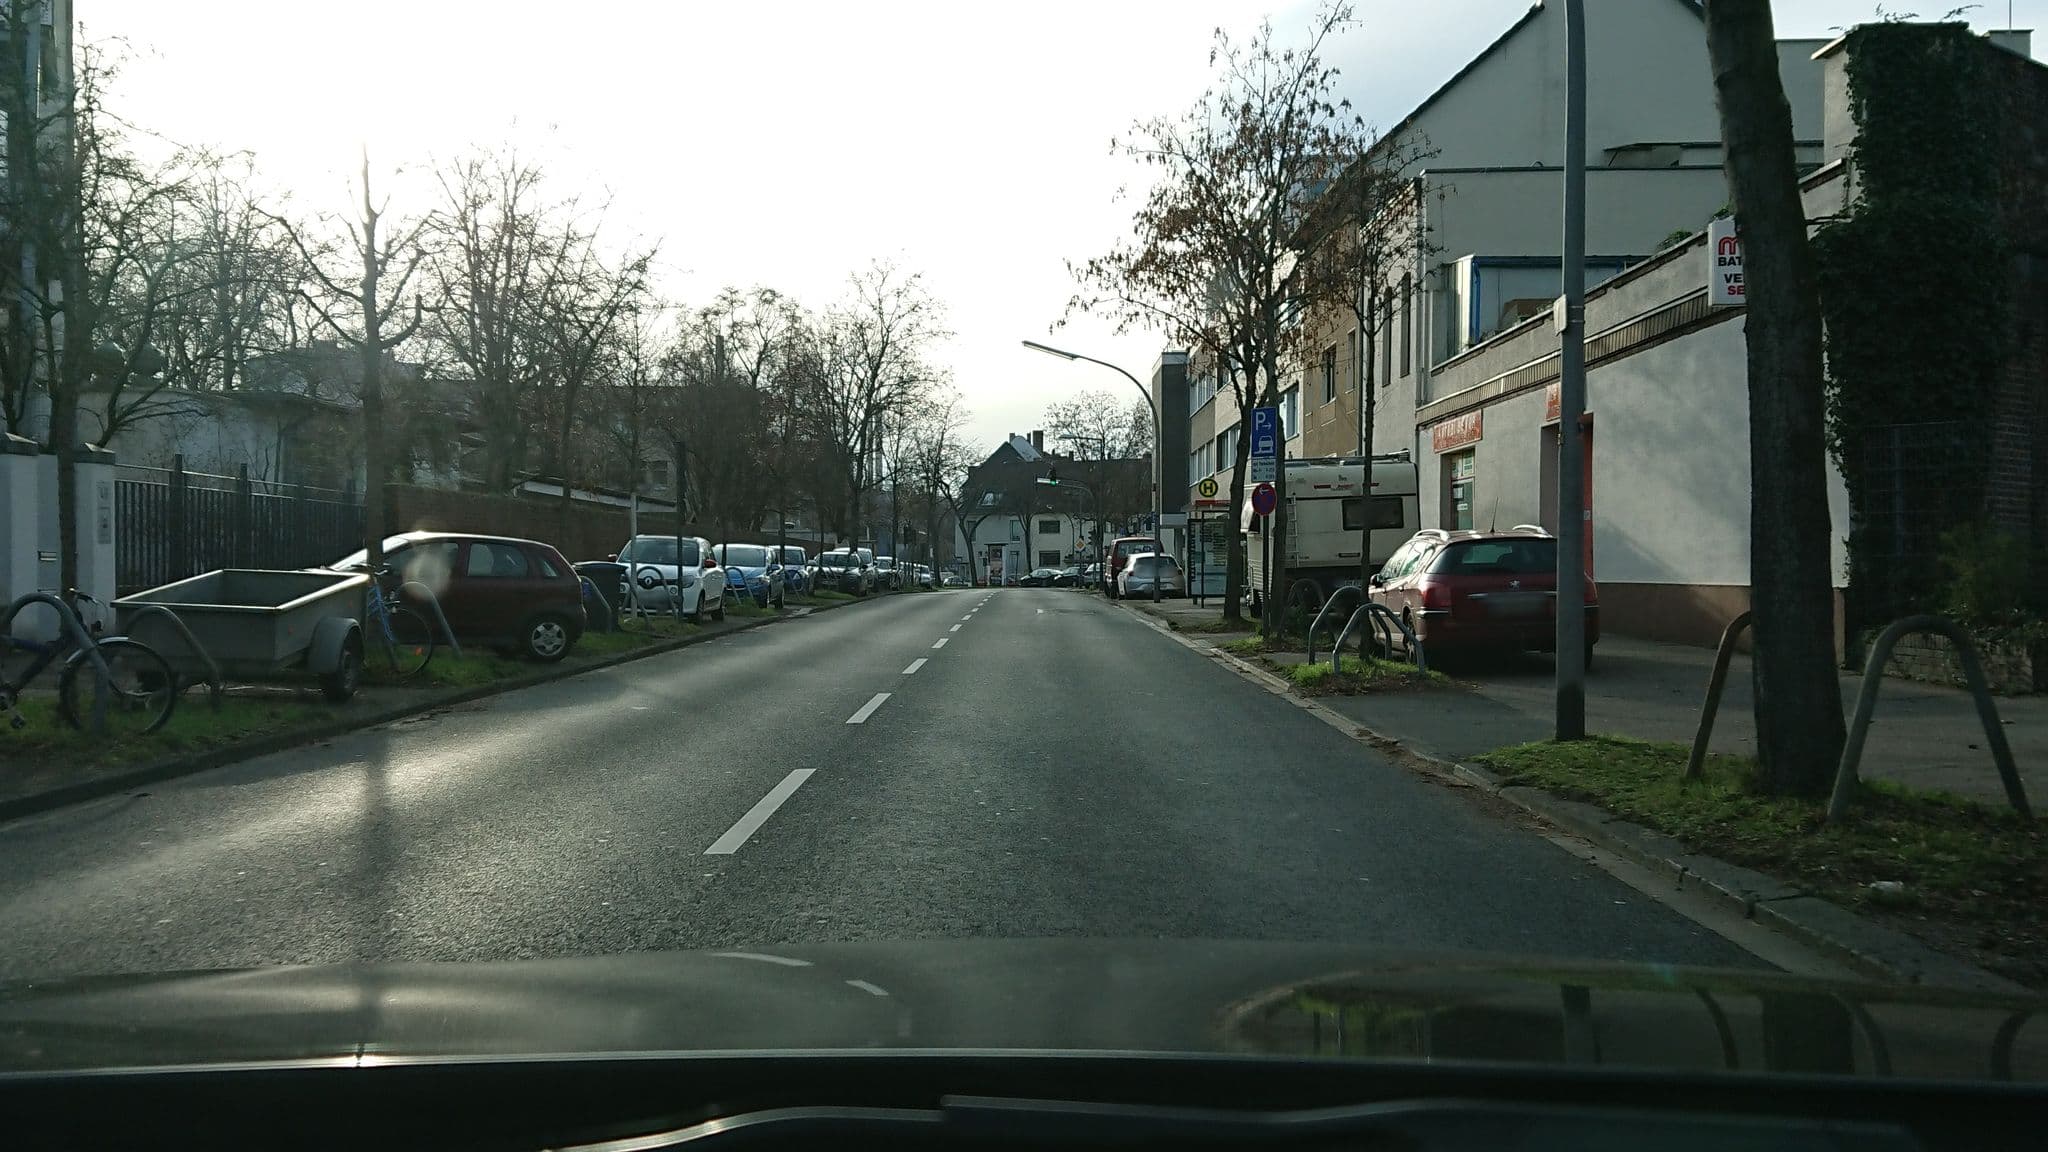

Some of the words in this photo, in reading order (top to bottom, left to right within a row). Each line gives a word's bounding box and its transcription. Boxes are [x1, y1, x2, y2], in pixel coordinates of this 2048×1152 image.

[1724, 273, 1743, 284] VE
[1727, 285, 1745, 296] SE
[1255, 411, 1266, 431] P
[1203, 482, 1214, 494] H
